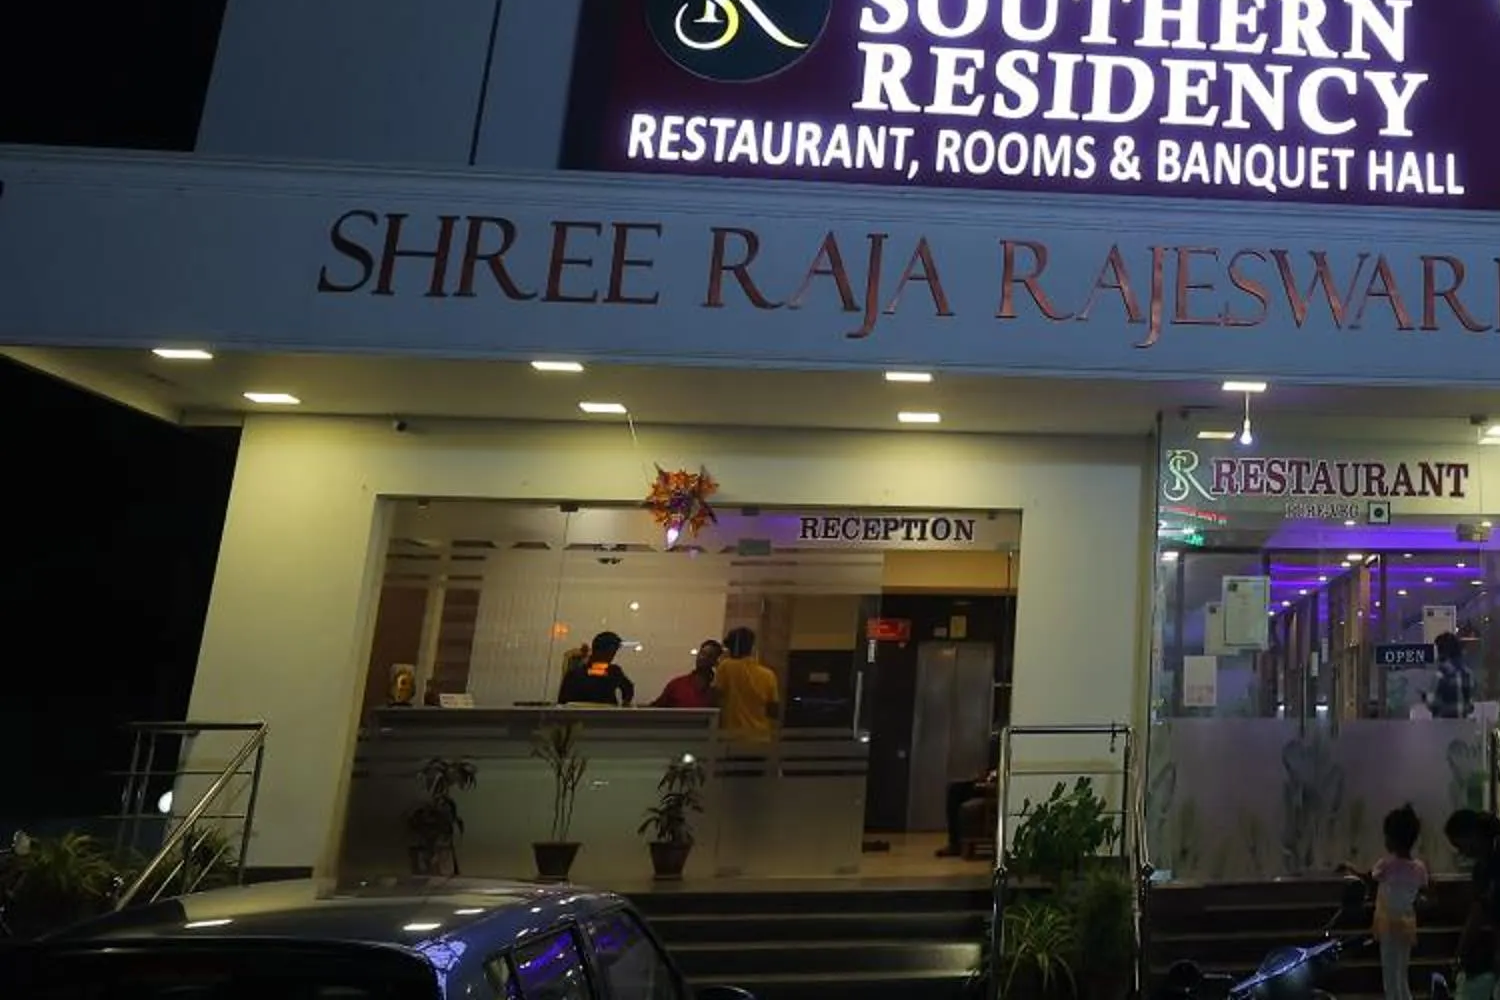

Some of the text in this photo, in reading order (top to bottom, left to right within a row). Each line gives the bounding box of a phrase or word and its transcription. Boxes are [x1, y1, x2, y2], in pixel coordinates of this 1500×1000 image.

[852, 41, 1430, 137] RESIDENCY
[628, 113, 1465, 195] RESTAURANT, ROOMS & BANQUET HALL
[318, 210, 662, 304] SHREE
[702, 226, 955, 339] RAJA
[1211, 457, 1470, 498] RESTAURANT
[799, 516, 975, 541] RECEPTION
[1384, 648, 1426, 664] OPEN
